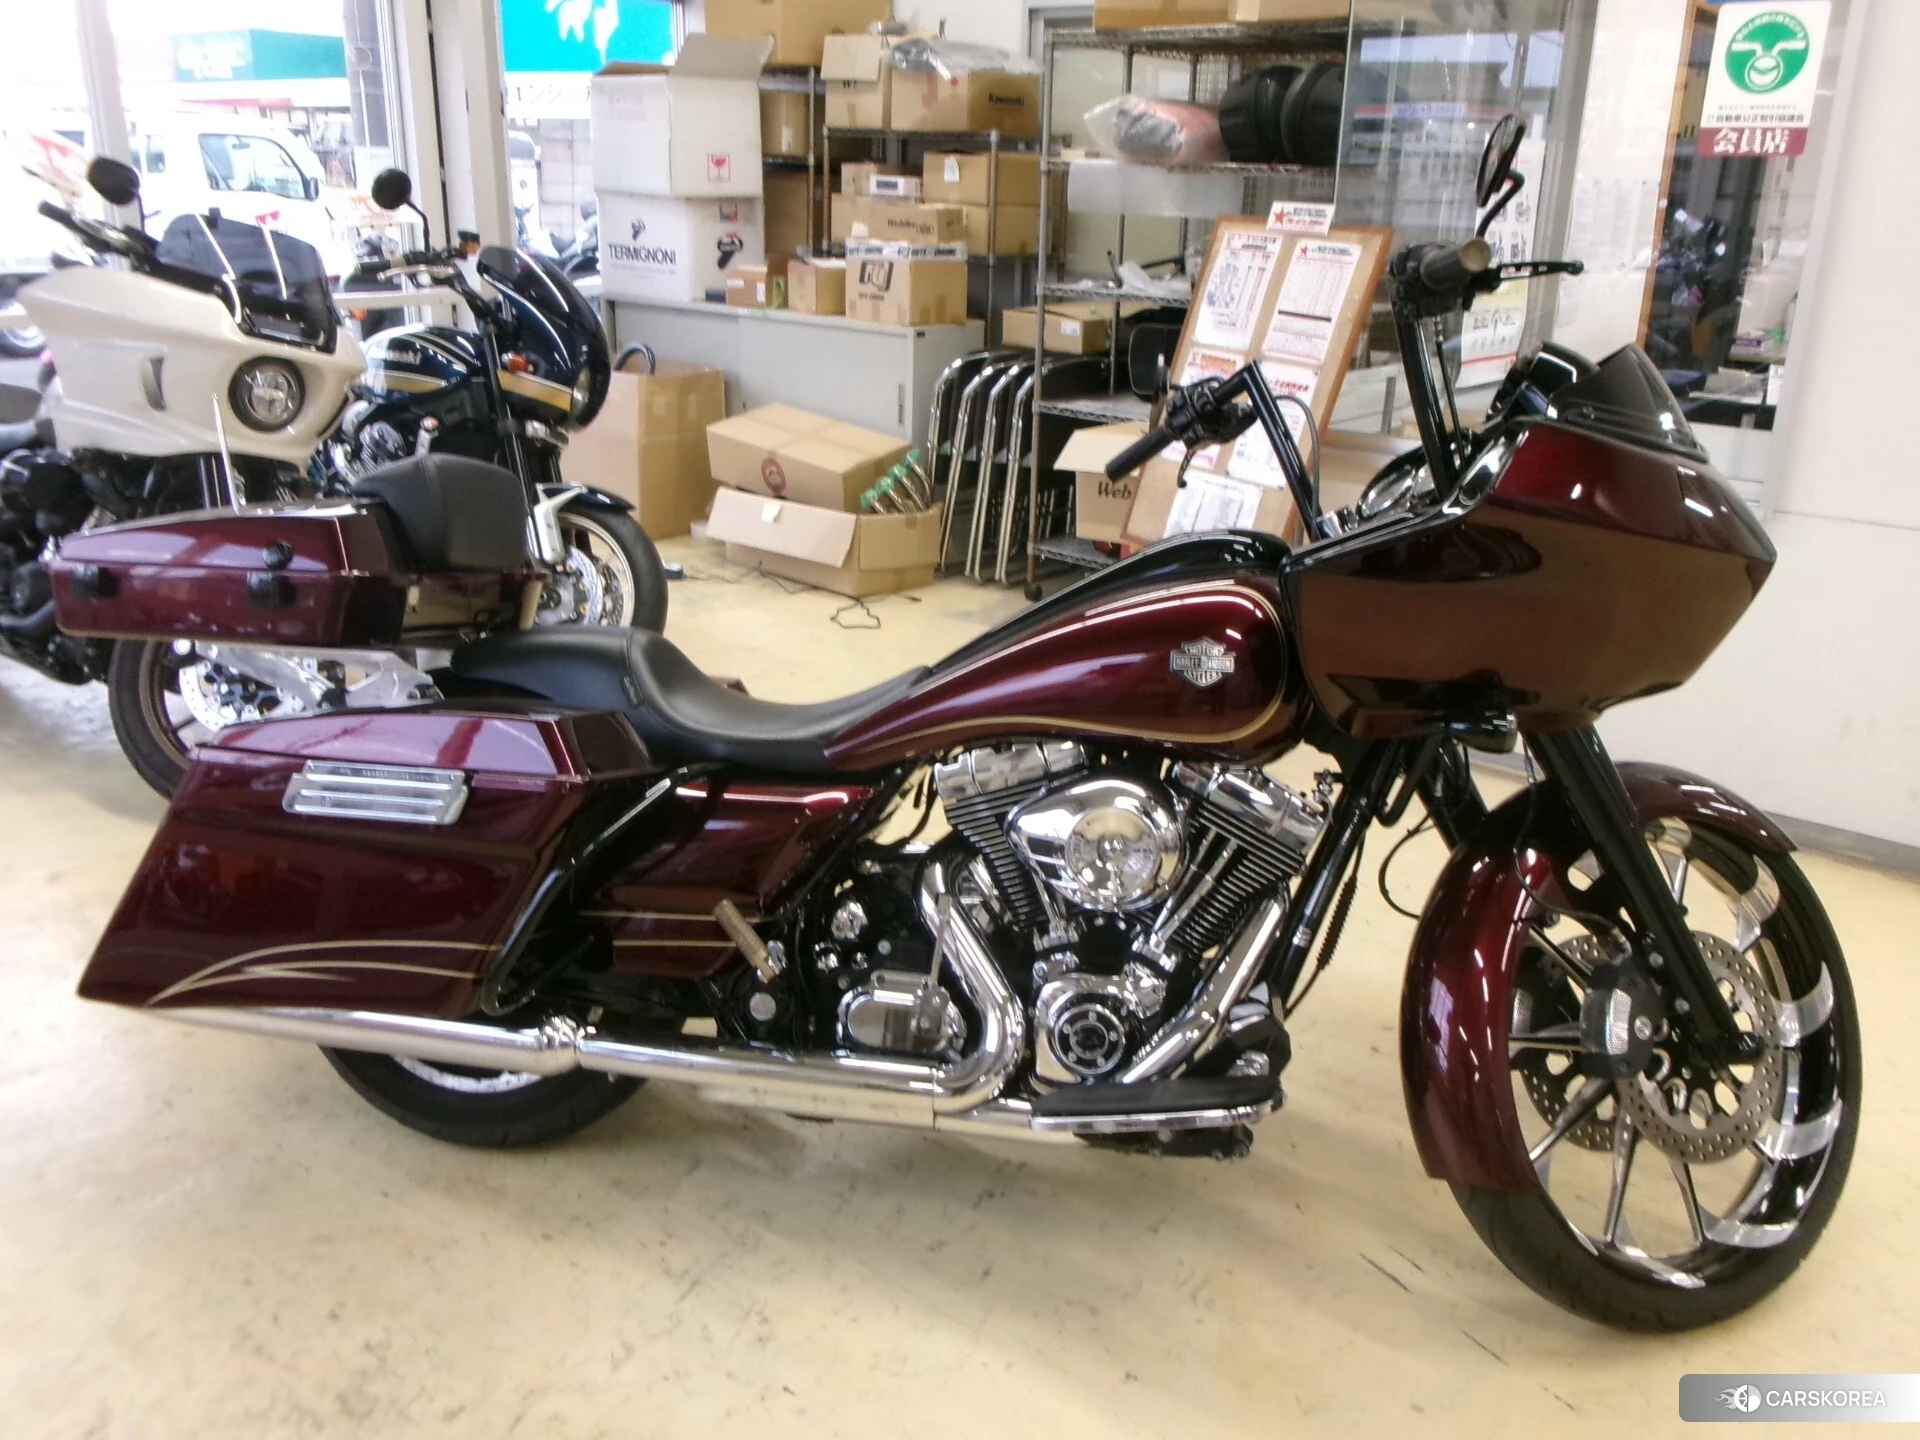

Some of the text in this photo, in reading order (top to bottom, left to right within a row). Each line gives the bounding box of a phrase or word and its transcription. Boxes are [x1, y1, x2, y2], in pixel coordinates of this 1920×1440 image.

[1713, 127, 1789, 154] 会員店
[607, 243, 677, 266] TERMIGNONI
